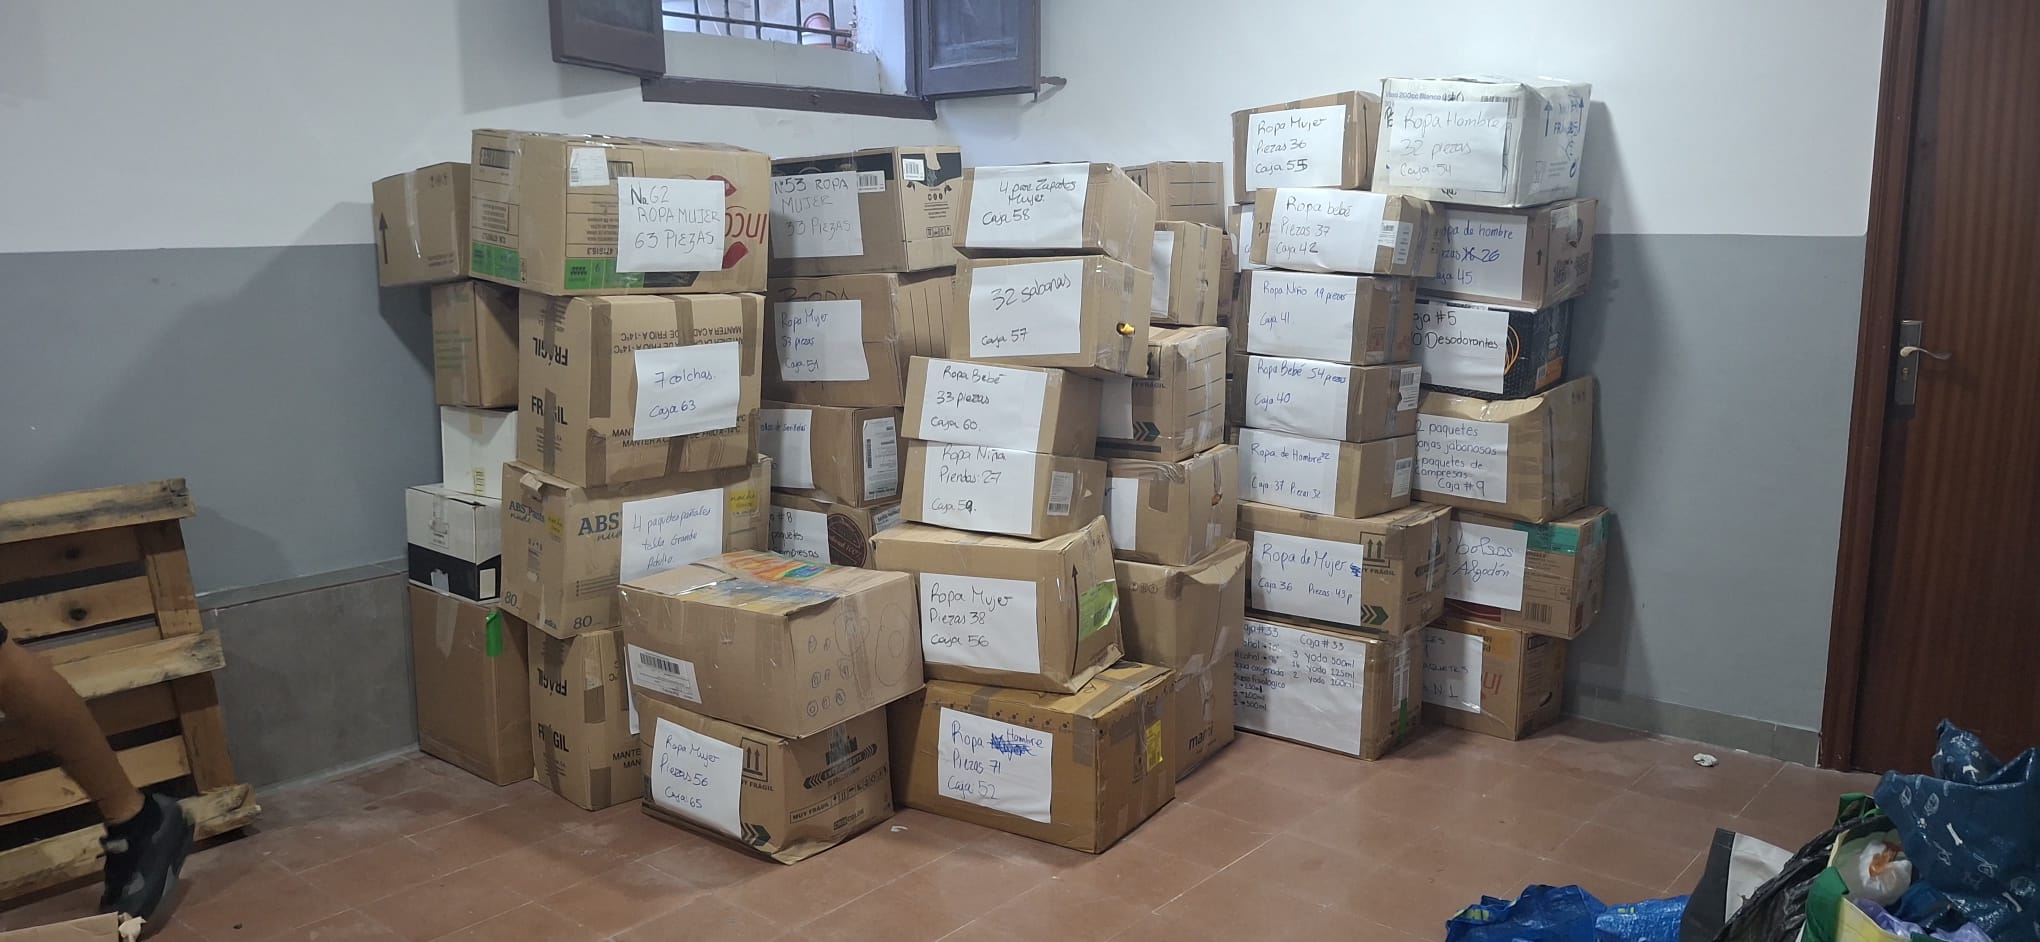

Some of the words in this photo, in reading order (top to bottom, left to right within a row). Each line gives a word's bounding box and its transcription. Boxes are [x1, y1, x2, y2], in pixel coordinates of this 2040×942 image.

[1257, 119, 1286, 136] Ropa
[1290, 115, 1328, 132] Mujer
[1404, 106, 1441, 138] Ropa
[1447, 111, 1500, 128] Hombre
[1256, 140, 1287, 155] Piezas
[1400, 162, 1430, 180] Caja
[815, 177, 849, 191] ROPA
[1000, 180, 1009, 194] 4
[781, 194, 833, 215] MUJER
[1286, 195, 1321, 218] Ropa
[638, 206, 674, 224] ROPA
[678, 207, 721, 224] MUJER
[1012, 208, 1030, 221] 58
[1281, 216, 1311, 236] Piezas
[1315, 224, 1331, 237] 37
[1464, 219, 1473, 236] de
[1478, 223, 1513, 239] hombre
[635, 231, 659, 249] 63
[1299, 242, 1319, 255] 42
[1458, 267, 1473, 285] 45
[1021, 273, 1072, 303] sabanas
[1263, 280, 1283, 299] Ropa
[781, 311, 802, 333] Ropa
[1011, 327, 1029, 342] 57
[1425, 330, 1498, 349] Desodorantes
[943, 365, 969, 382] Ropa
[1257, 358, 1278, 379] Ropa
[1281, 360, 1305, 376] Bebé
[655, 372, 665, 389] 7
[681, 399, 697, 412] 63
[936, 391, 954, 405] 33
[1276, 392, 1291, 403] 40
[1429, 422, 1479, 438] paquetes
[942, 442, 972, 464] Ropa
[977, 446, 1007, 462] Niña
[1251, 442, 1276, 463] Ropa
[1281, 446, 1290, 458] de
[1292, 448, 1321, 463] Hombre
[1444, 440, 1497, 456] jabonosas
[1421, 455, 1465, 469] paquetes
[1470, 459, 1484, 469] de
[1275, 480, 1284, 491] 37
[1437, 479, 1460, 492] Caja
[509, 500, 526, 514] ABS
[577, 511, 620, 537] ABS
[632, 513, 642, 532] 4
[1262, 543, 1295, 571] Ropa
[1300, 548, 1310, 565] de
[1313, 550, 1347, 577] Mujer
[1452, 560, 1510, 583] Algodón
[1257, 576, 1277, 594] Caja
[1308, 582, 1330, 597] Piezas
[504, 591, 518, 607] 80
[931, 582, 966, 608] Ropa
[972, 585, 1014, 612] Mujer
[573, 615, 593, 630] 80
[929, 607, 966, 625] Piezas
[969, 611, 986, 625] 38
[968, 635, 989, 647] 56
[1299, 634, 1320, 649] Caja
[951, 719, 985, 754] Ropa
[1006, 727, 1045, 748] Hombre
[612, 747, 640, 761] MANTE
[665, 734, 687, 757] Ropa
[689, 743, 720, 768] Mujer
[953, 748, 984, 775] Piezas
[989, 760, 1001, 775] 71
[693, 773, 709, 787] 56
[947, 776, 973, 800] Caja
[978, 780, 1000, 800] 52
[689, 796, 703, 809] 65
